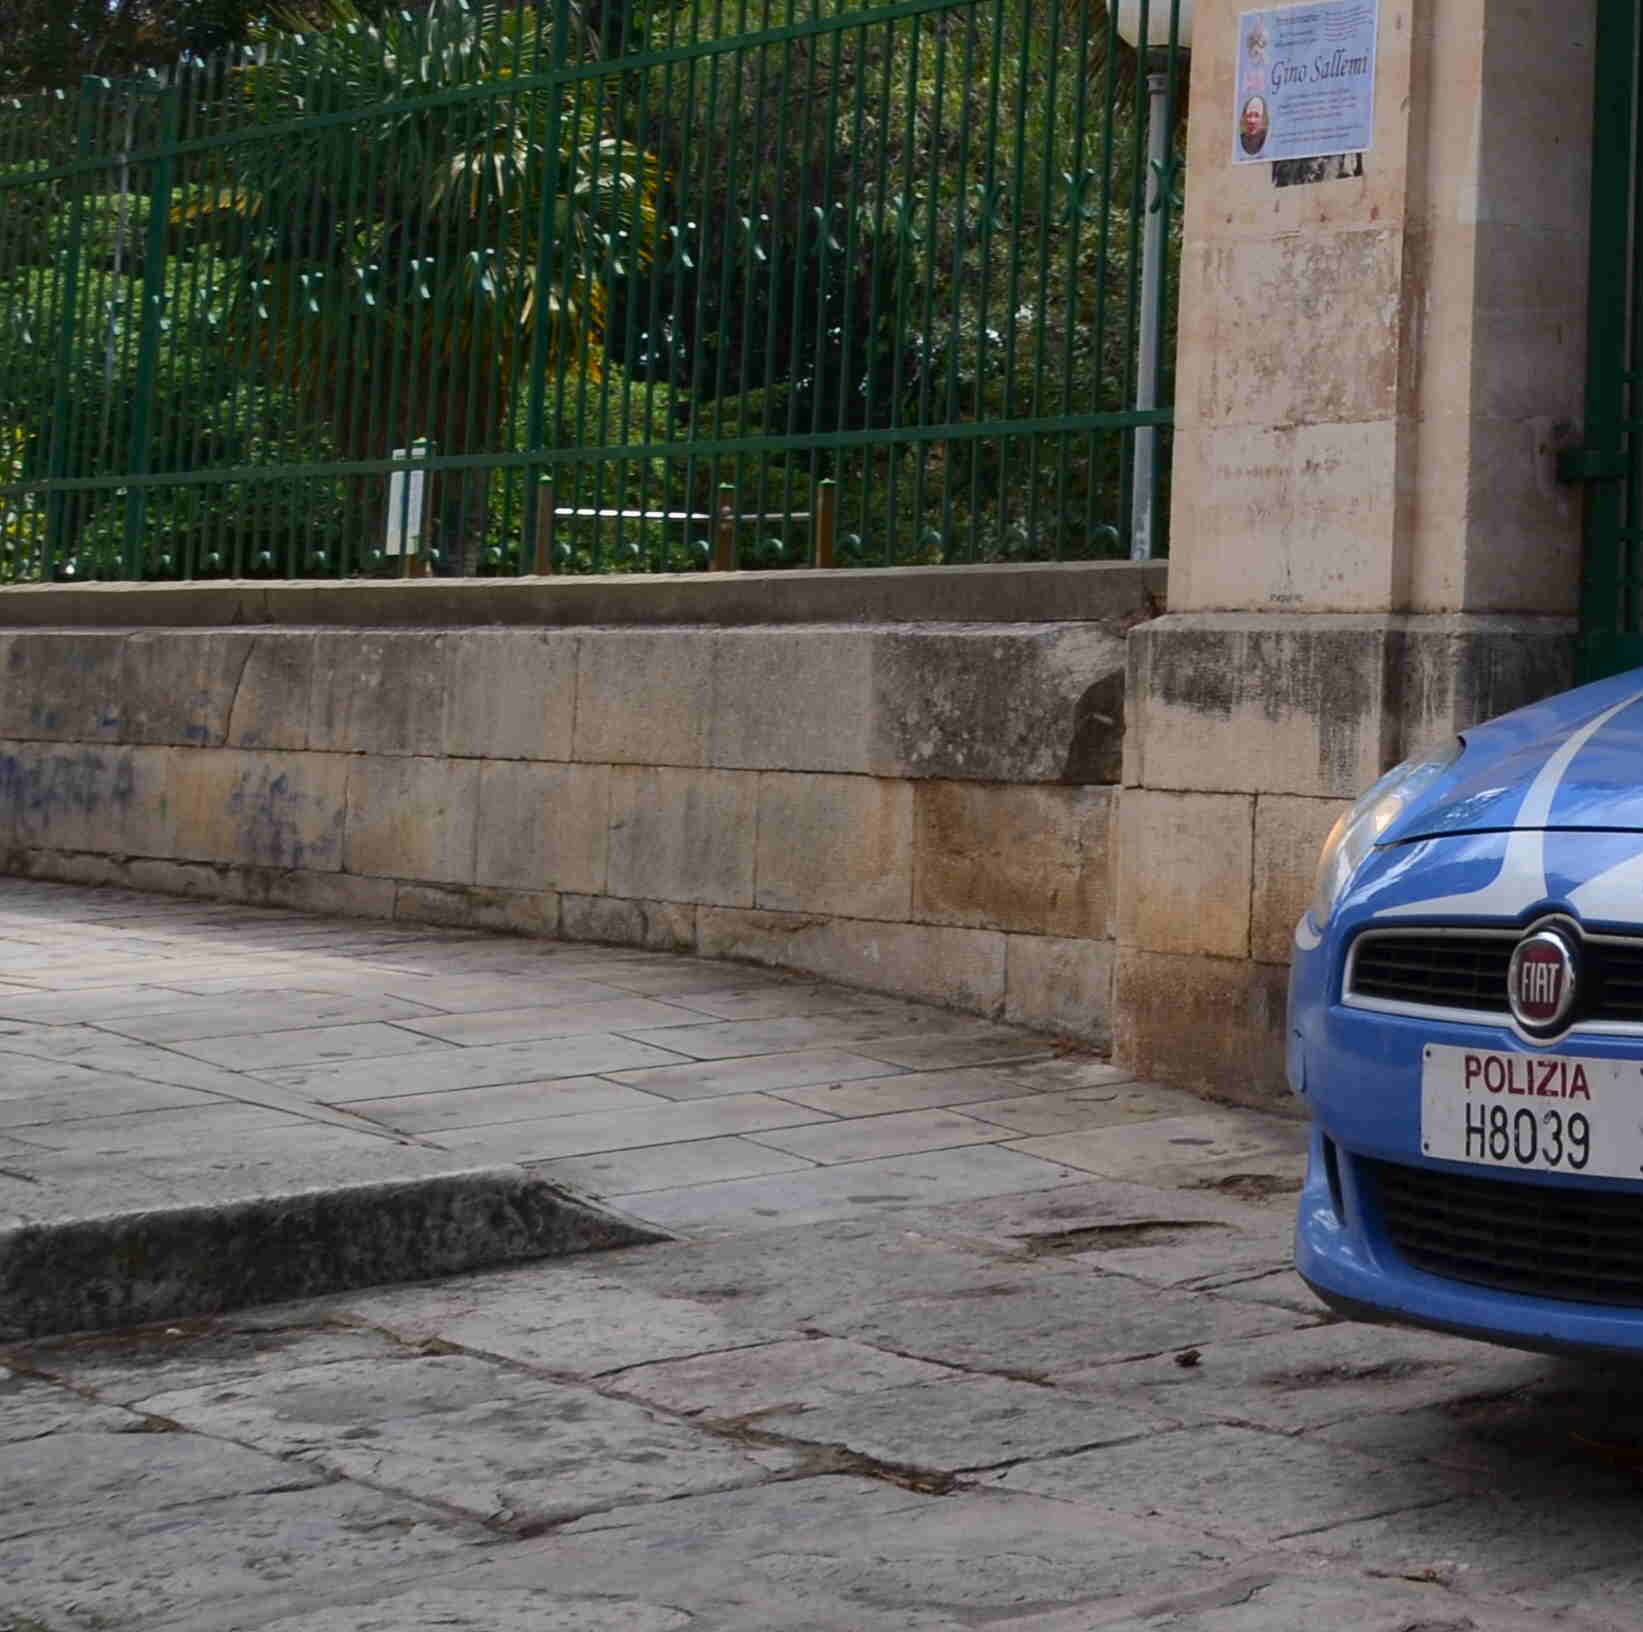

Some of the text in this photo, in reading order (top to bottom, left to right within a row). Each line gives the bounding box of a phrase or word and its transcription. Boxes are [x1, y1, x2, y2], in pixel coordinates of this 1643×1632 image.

[1521, 962, 1560, 1004] FIAT
[1464, 1055, 1591, 1100] POLIZIA
[1465, 1103, 1590, 1170] H8039
